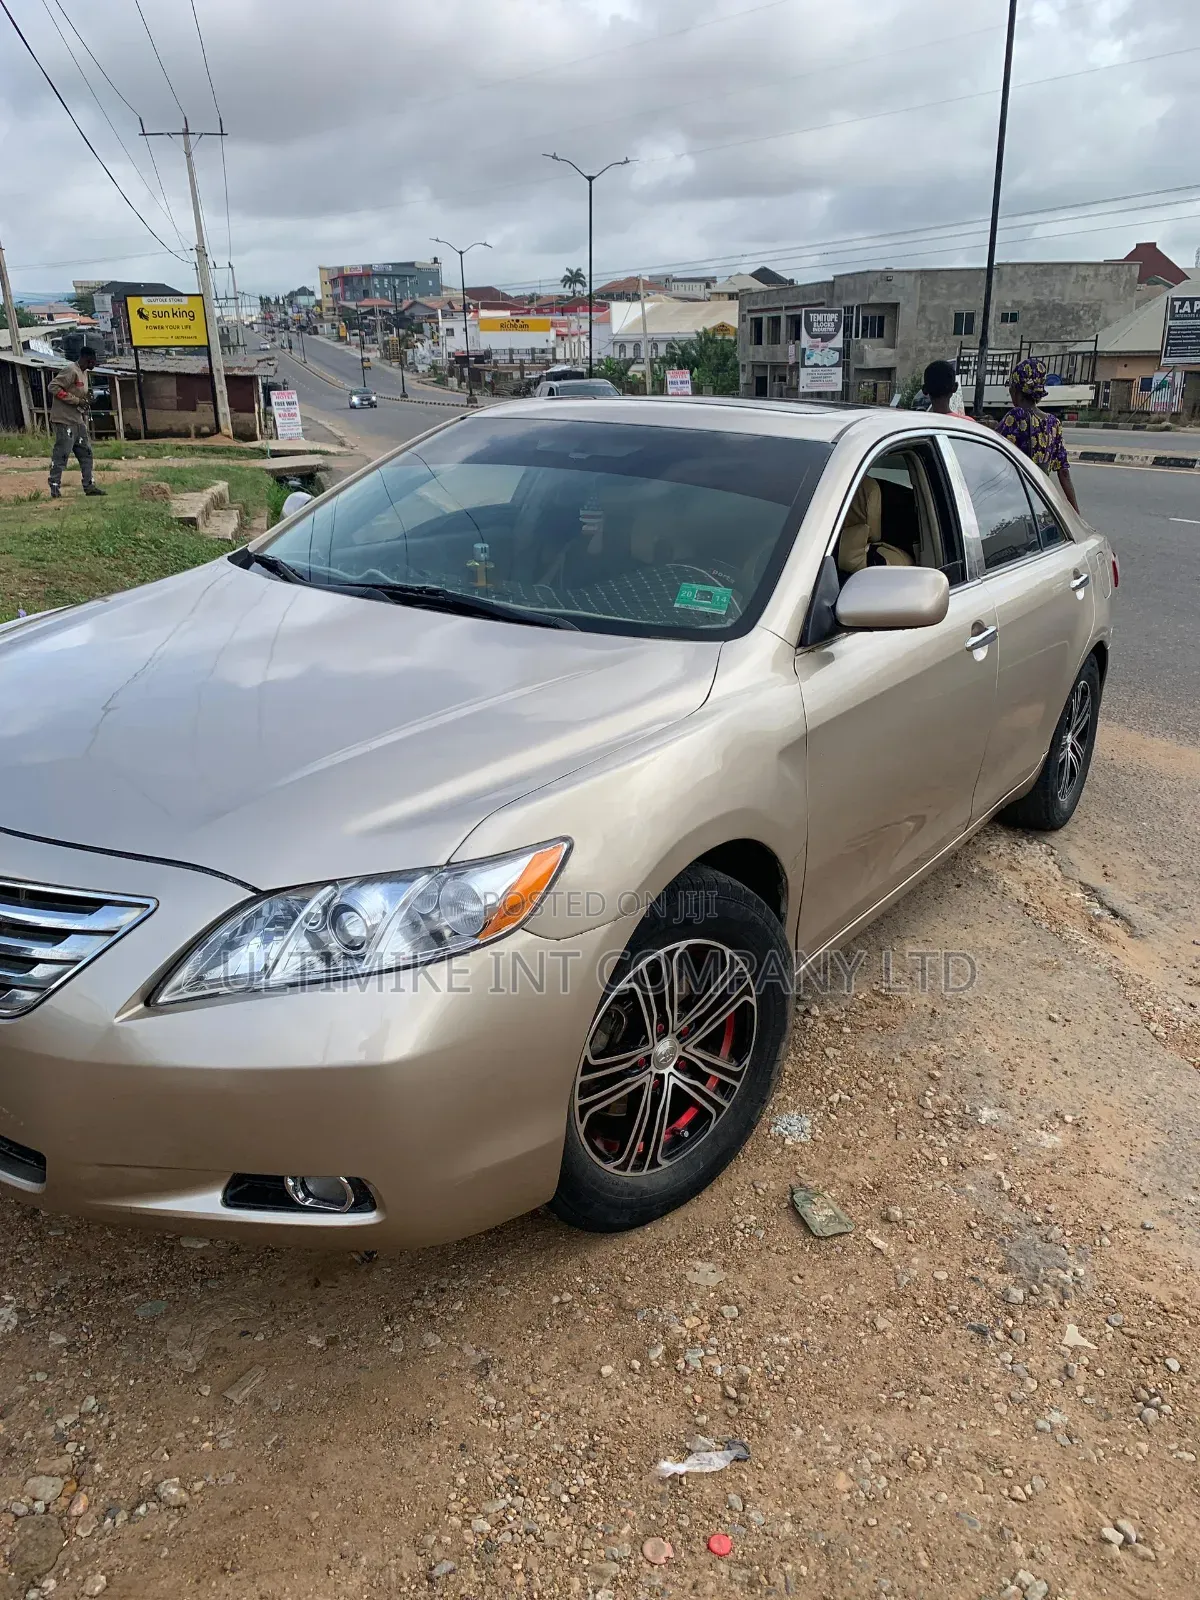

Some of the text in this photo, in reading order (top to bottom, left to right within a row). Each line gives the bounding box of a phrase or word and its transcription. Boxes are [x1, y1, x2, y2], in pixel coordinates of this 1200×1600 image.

[152, 308, 195, 321] sun king
[810, 314, 838, 322] TEMITOPE
